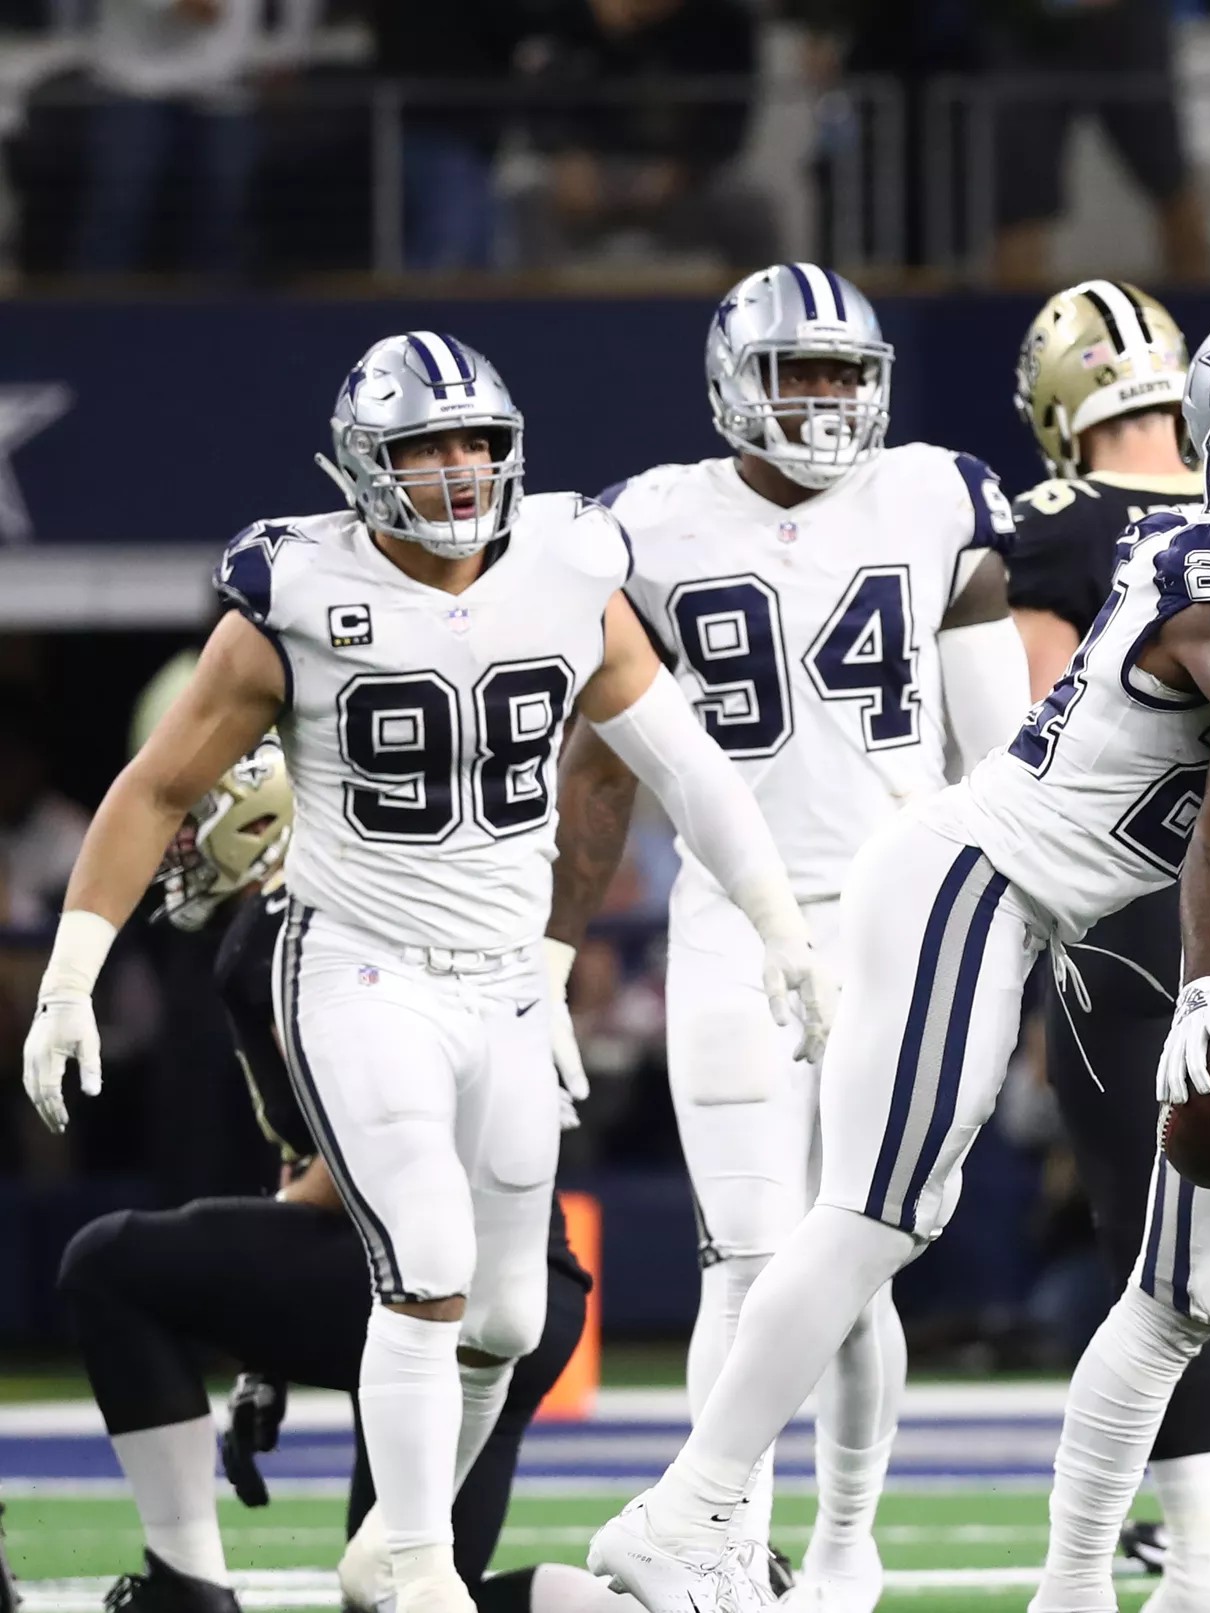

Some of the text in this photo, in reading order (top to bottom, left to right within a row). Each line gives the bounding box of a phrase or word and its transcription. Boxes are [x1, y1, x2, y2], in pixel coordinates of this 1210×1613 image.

[330, 605, 370, 638] C
[667, 564, 921, 761] 94
[337, 655, 575, 845] 98
